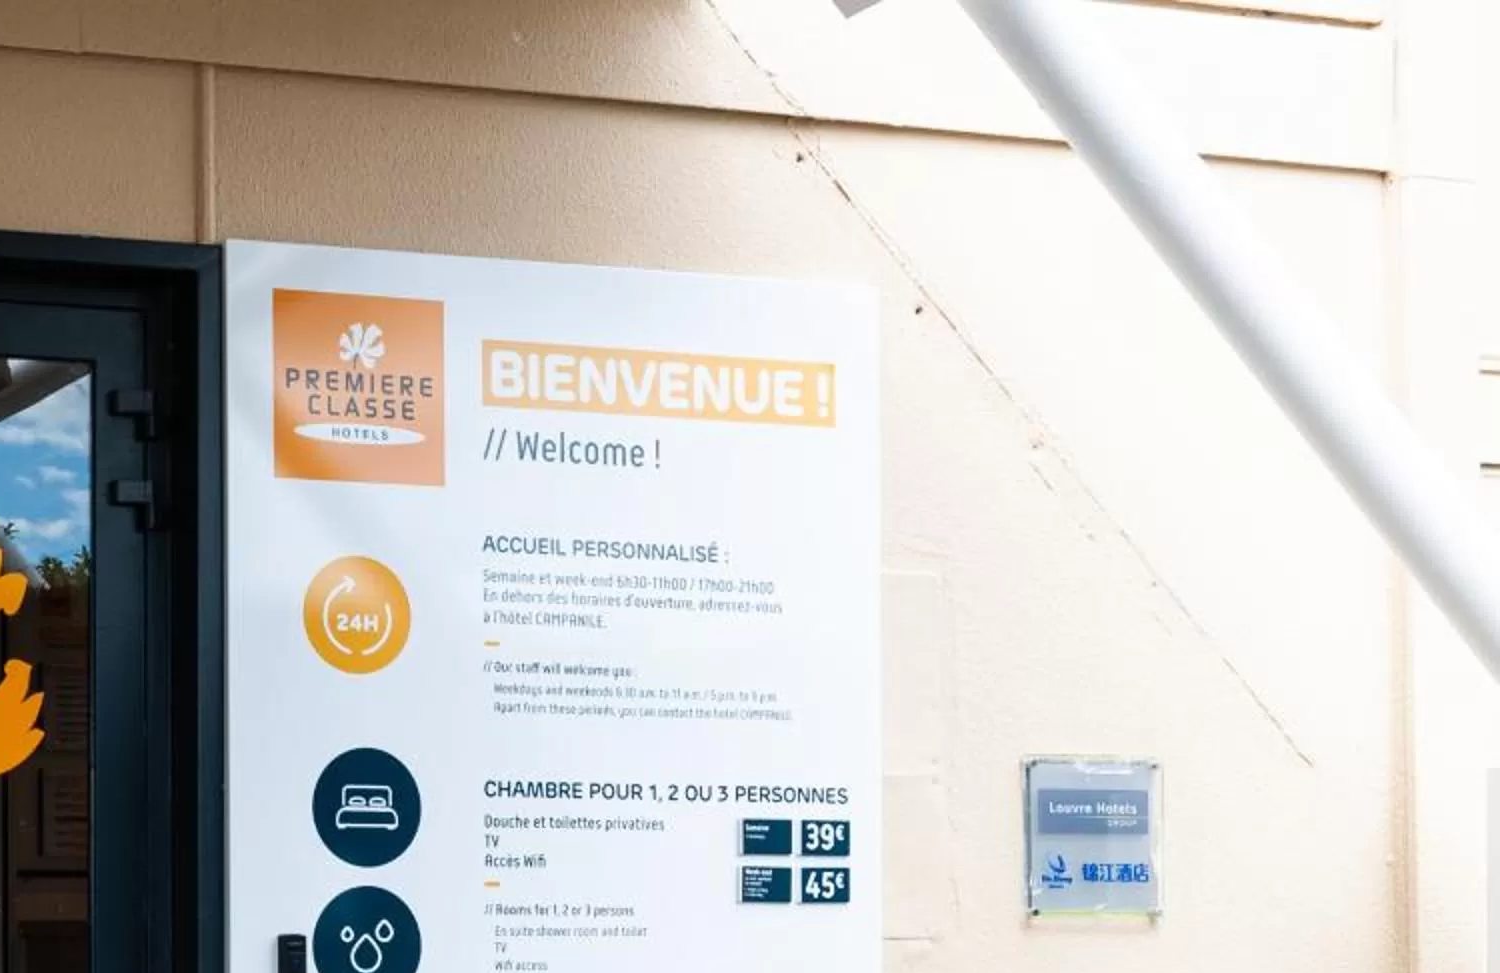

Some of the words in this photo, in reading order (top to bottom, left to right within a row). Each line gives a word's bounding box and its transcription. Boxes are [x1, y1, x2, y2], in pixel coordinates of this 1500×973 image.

[285, 367, 434, 398] PREMIERE
[489, 350, 805, 417] BIENVENUE
[816, 372, 831, 418] !
[308, 394, 416, 421] CLASSE
[331, 426, 389, 441] HOTELS
[515, 431, 646, 469] Welcome
[654, 439, 661, 470] !
[482, 535, 567, 557] ACCUEIL
[571, 539, 719, 563] PERSONNALISÉ
[483, 568, 535, 585] Semaine
[539, 572, 552, 586] et
[554, 573, 614, 589] week-end
[483, 588, 499, 603] En
[501, 589, 544, 604] dehors
[546, 591, 569, 606] des
[571, 592, 622, 608] horaires
[336, 612, 379, 633] 24H
[483, 779, 583, 800] CHAMBRE
[589, 782, 643, 800] POUR
[649, 784, 663, 803] 1,
[668, 784, 679, 801] 2
[685, 784, 713, 802] OU
[717, 785, 729, 802] 3
[735, 785, 849, 805] PERSONNES
[1048, 801, 1093, 815] Louvre
[1096, 802, 1138, 816] Hotels
[484, 814, 530, 829] Douche
[533, 815, 546, 829] et
[549, 815, 601, 830] toilettes
[605, 817, 665, 832] privatives
[484, 834, 501, 847] TV
[805, 823, 845, 851] 39€
[484, 852, 521, 868] Accès
[523, 854, 547, 869] Wifi
[805, 871, 845, 899] 45€
[495, 903, 533, 916] Rooms
[593, 905, 635, 919] persons
